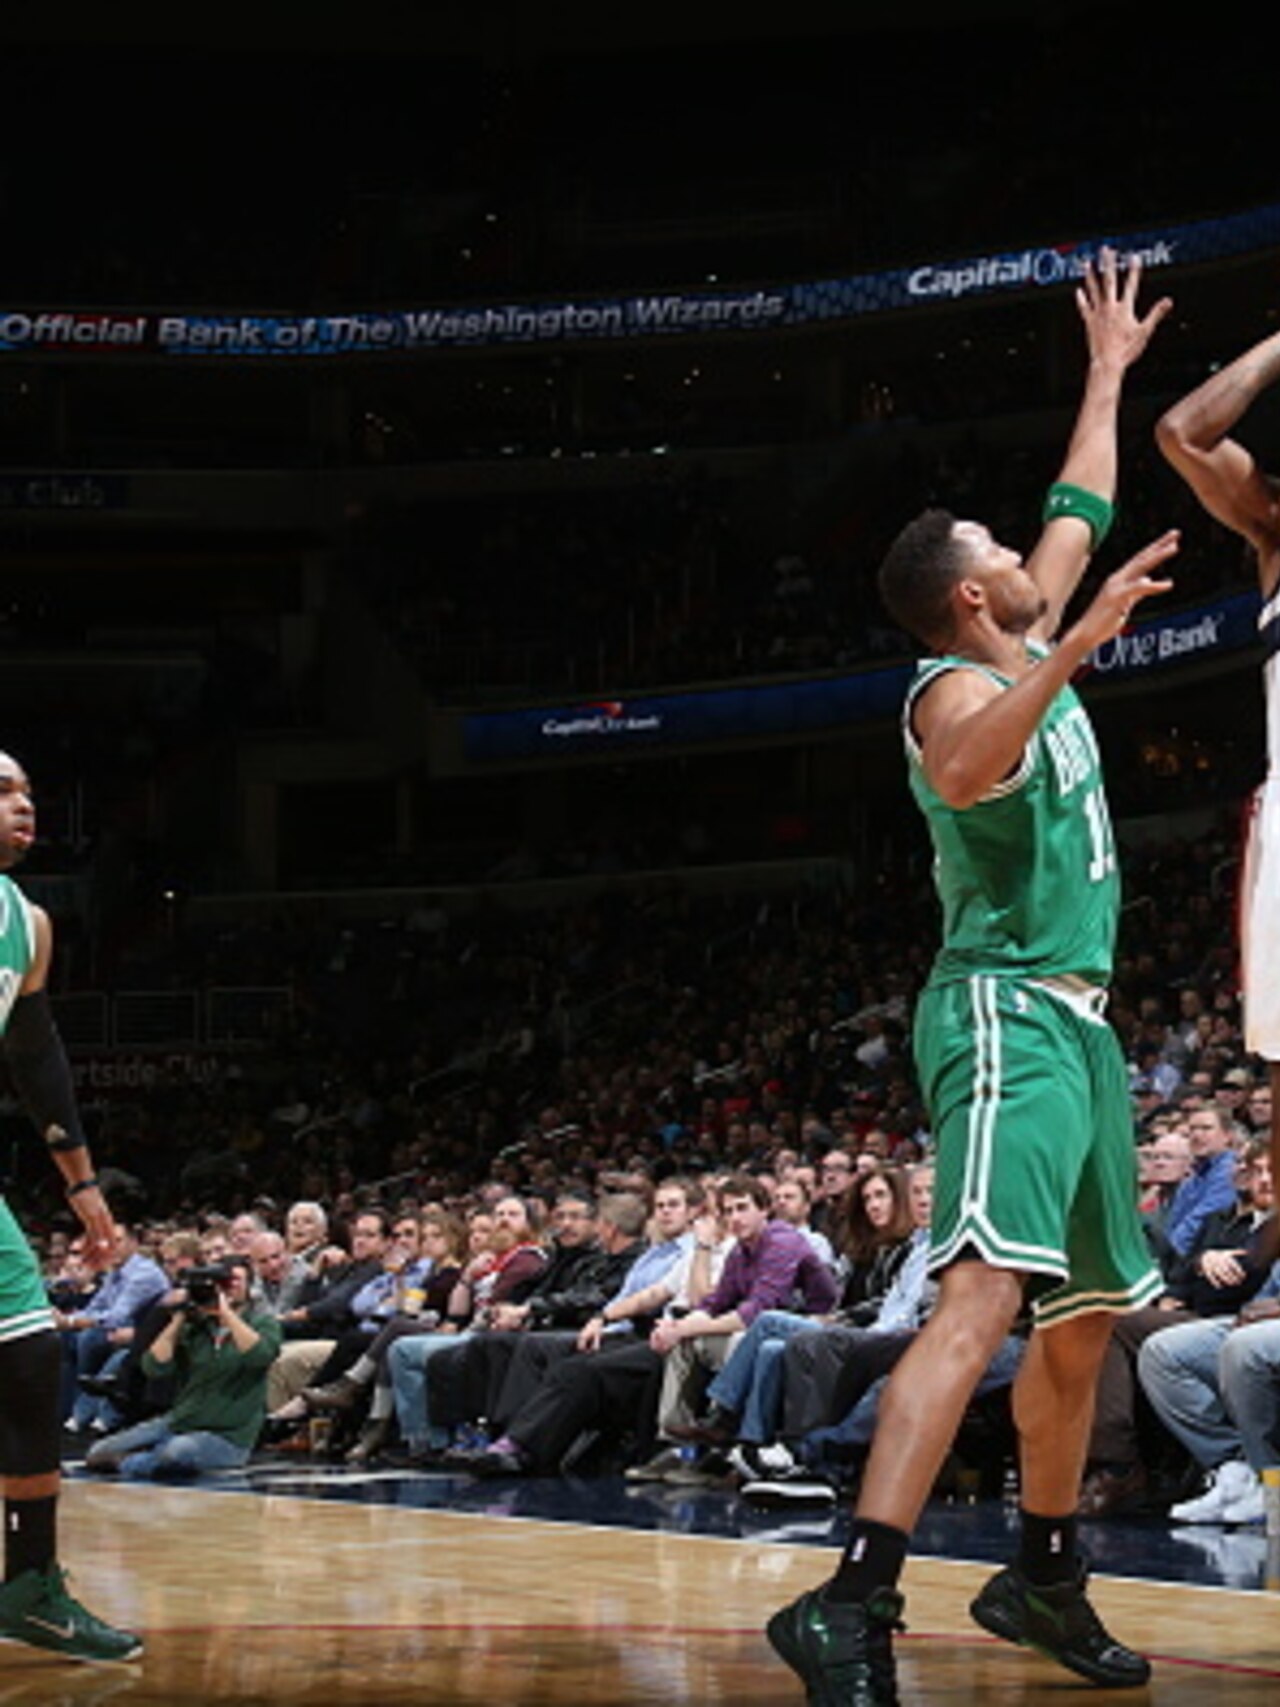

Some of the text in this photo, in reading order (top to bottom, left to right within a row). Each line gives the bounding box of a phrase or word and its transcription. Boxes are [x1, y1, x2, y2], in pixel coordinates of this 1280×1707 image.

[1, 291, 787, 347] Official Bank of The Washington Wizards
[1157, 613, 1220, 661] Bank
